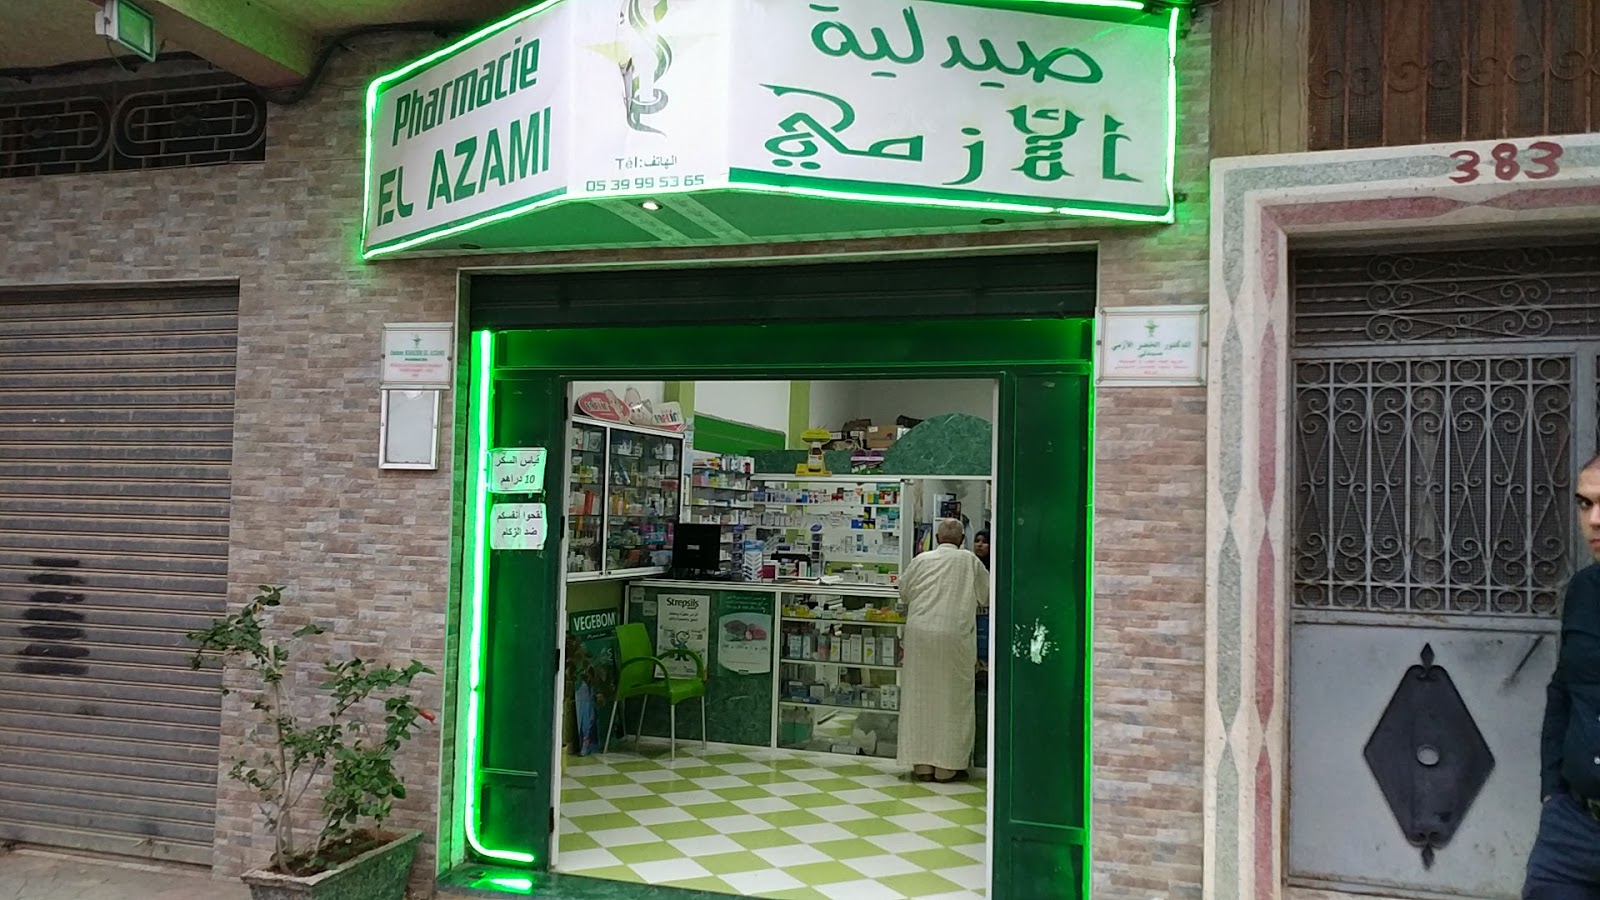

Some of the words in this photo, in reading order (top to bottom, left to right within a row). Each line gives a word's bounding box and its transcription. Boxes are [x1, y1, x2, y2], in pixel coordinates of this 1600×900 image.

[808, 3, 1103, 89] صيدلية
[392, 36, 541, 147] Pharmacie
[377, 164, 414, 227] EL
[427, 106, 551, 211] AZAMI
[1448, 141, 1564, 184] 383
[586, 180, 606, 192] 05
[610, 178, 630, 191] 39
[634, 177, 654, 189] 99
[659, 176, 679, 188] 53
[684, 174, 704, 187] 65
[524, 474, 536, 484] 10
[666, 597, 699, 609] Strepsils
[573, 611, 616, 631] VEGEBOM
